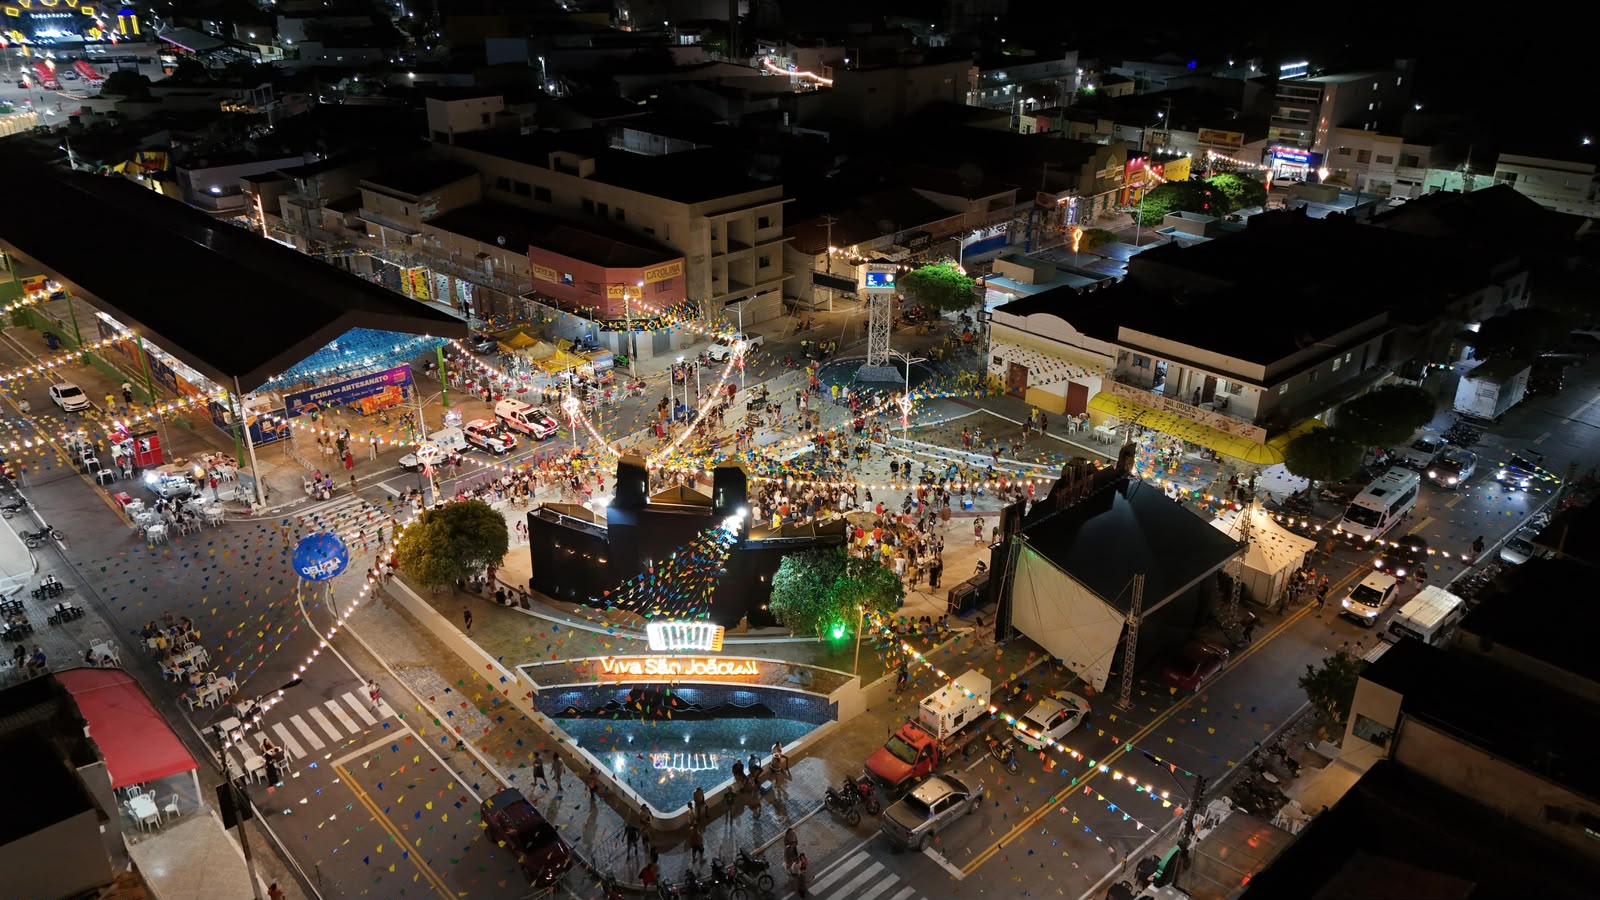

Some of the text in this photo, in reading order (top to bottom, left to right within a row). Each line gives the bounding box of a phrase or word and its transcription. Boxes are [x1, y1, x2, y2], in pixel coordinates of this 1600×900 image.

[646, 263, 680, 280] CAROLINA
[609, 286, 640, 296] CAROINA
[310, 389, 333, 400] FEIRA
[341, 374, 389, 393] ARTESANATO
[600, 657, 643, 675] Viva
